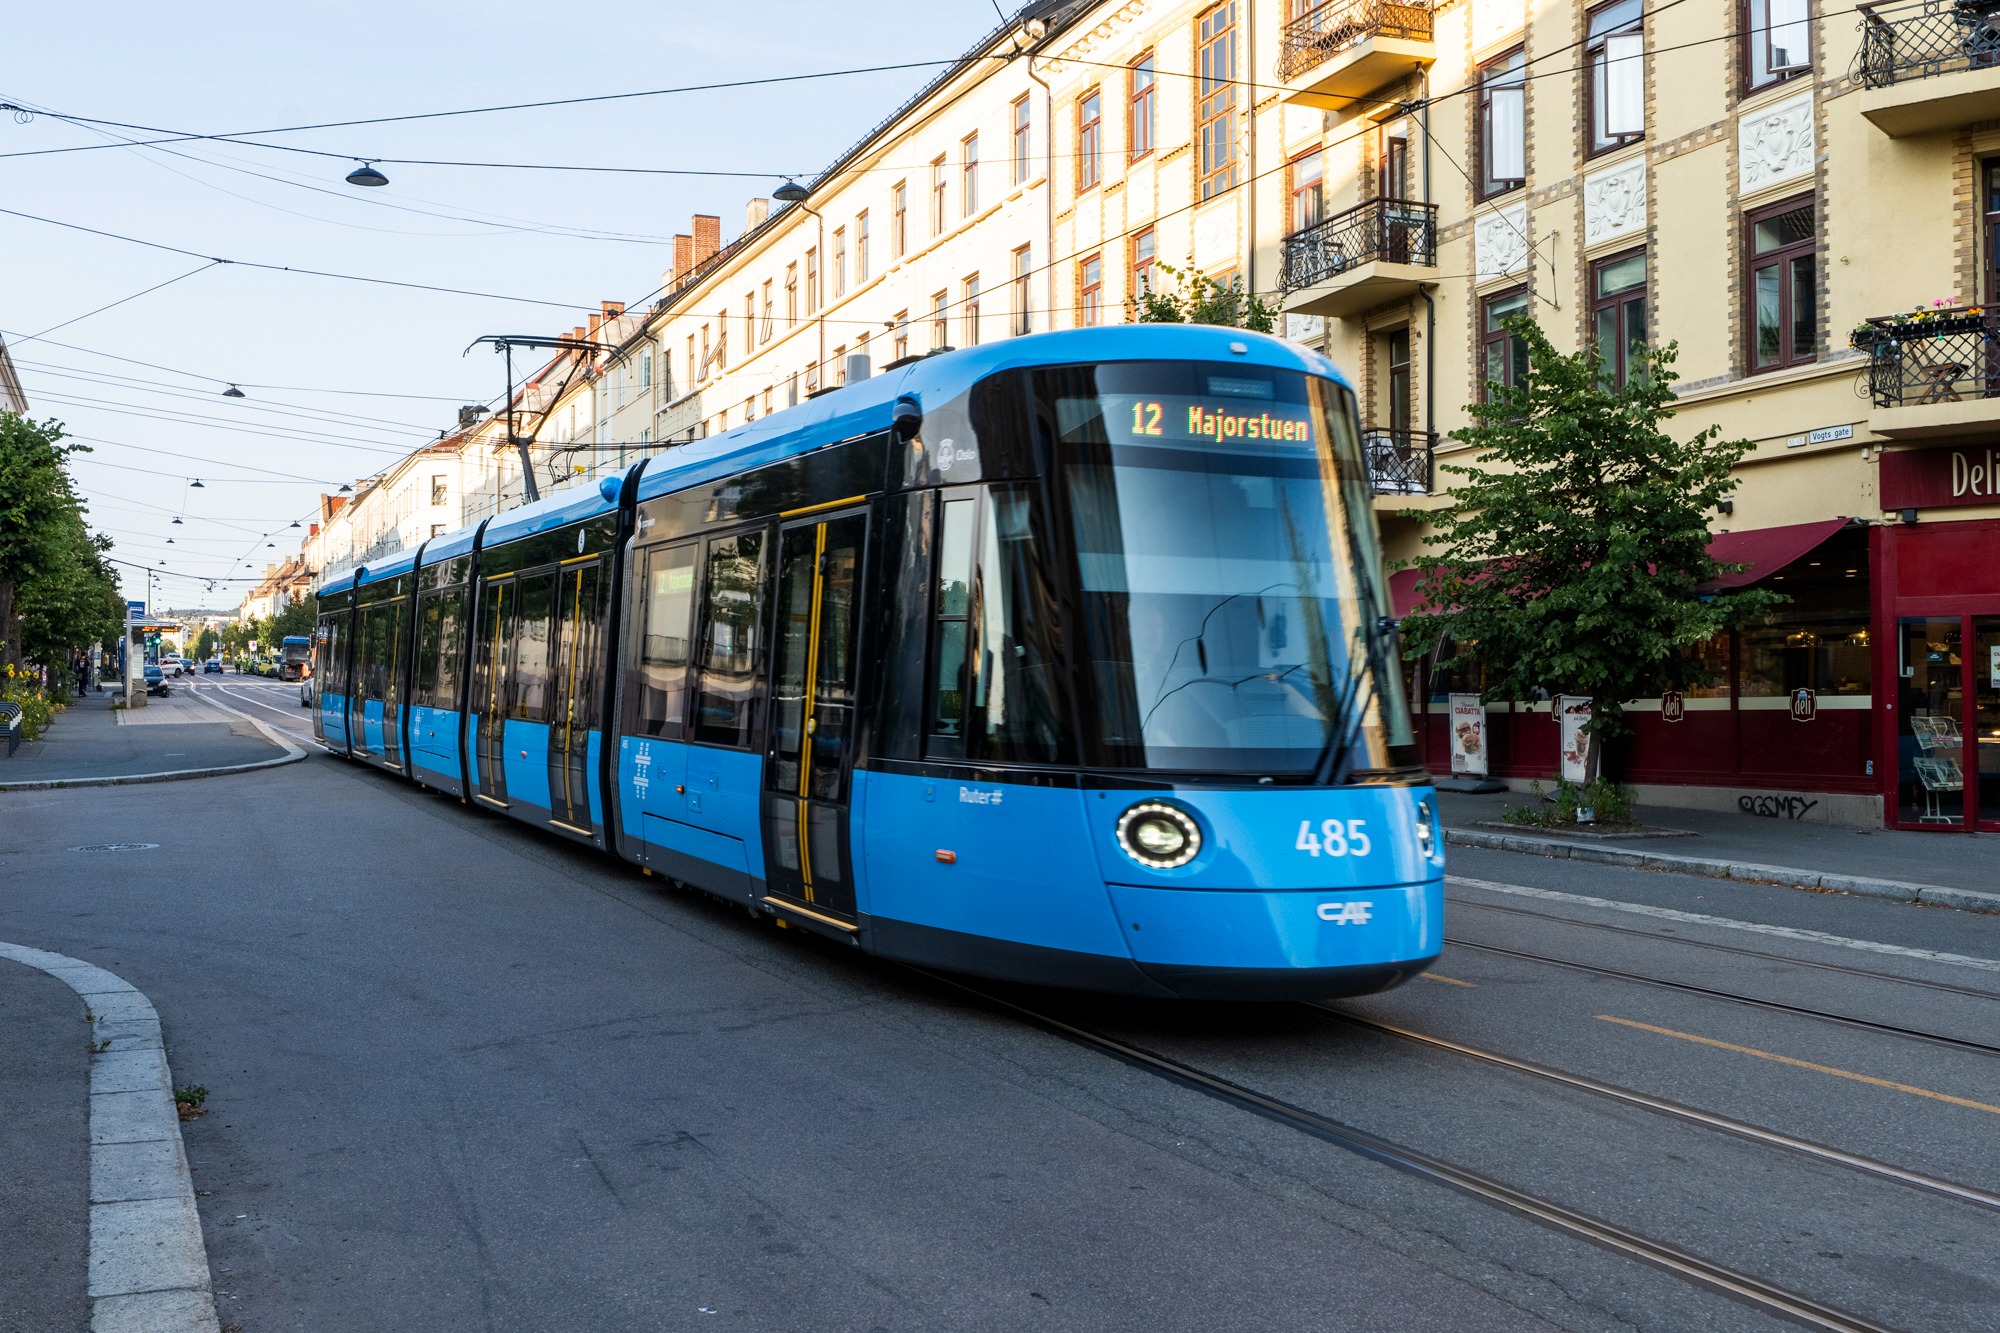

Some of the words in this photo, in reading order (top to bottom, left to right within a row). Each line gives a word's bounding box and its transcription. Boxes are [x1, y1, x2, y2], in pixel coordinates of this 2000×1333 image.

[1131, 401, 1163, 436] 12
[1188, 405, 1309, 443] Majorstuen
[1812, 431, 1831, 441] Vogts
[1834, 428, 1850, 439] gate
[1952, 449, 2000, 497] Deli
[1665, 695, 1680, 716] deli
[1794, 692, 1811, 715] deli
[1295, 818, 1372, 858] 485
[1316, 901, 1374, 926] CAF
